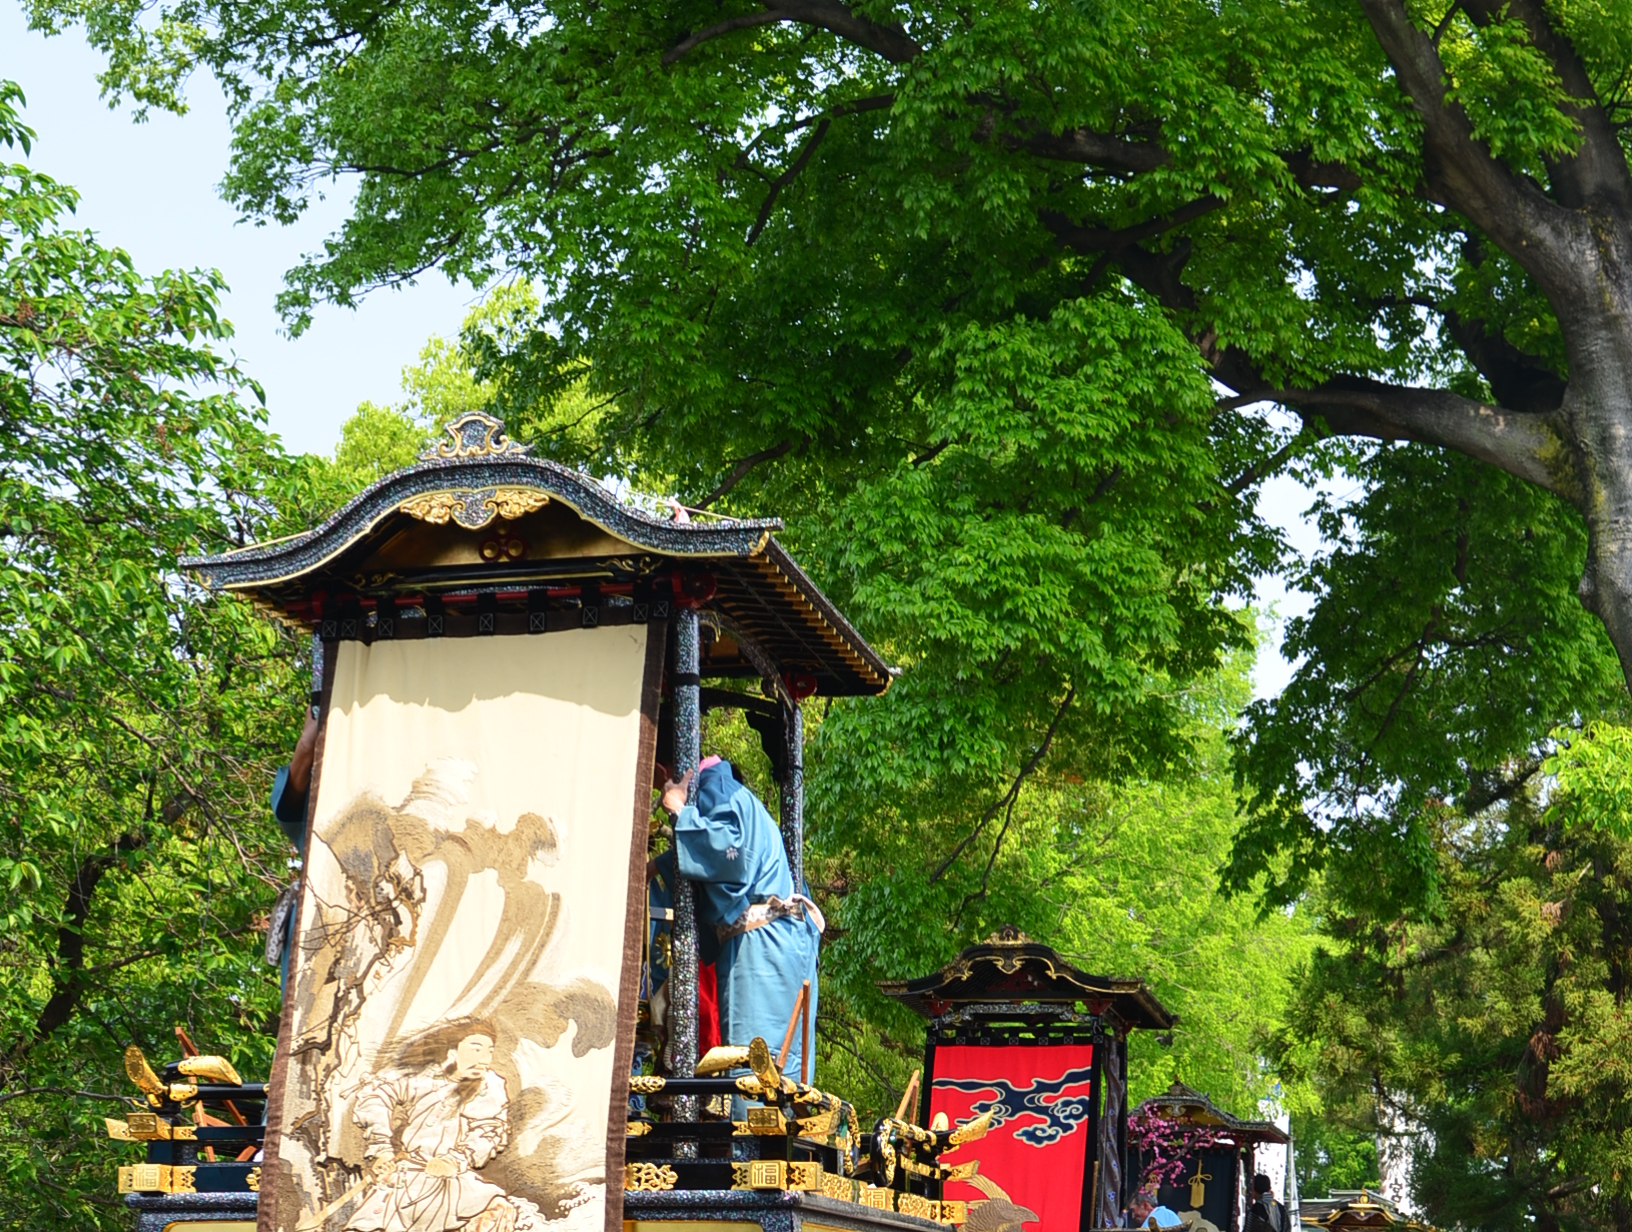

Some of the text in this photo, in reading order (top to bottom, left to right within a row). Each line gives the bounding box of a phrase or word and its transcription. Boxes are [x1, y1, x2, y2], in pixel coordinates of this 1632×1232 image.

[134, 1167, 157, 1188] 福
[753, 1162, 778, 1186] 福
[866, 1189, 886, 1209] 福
